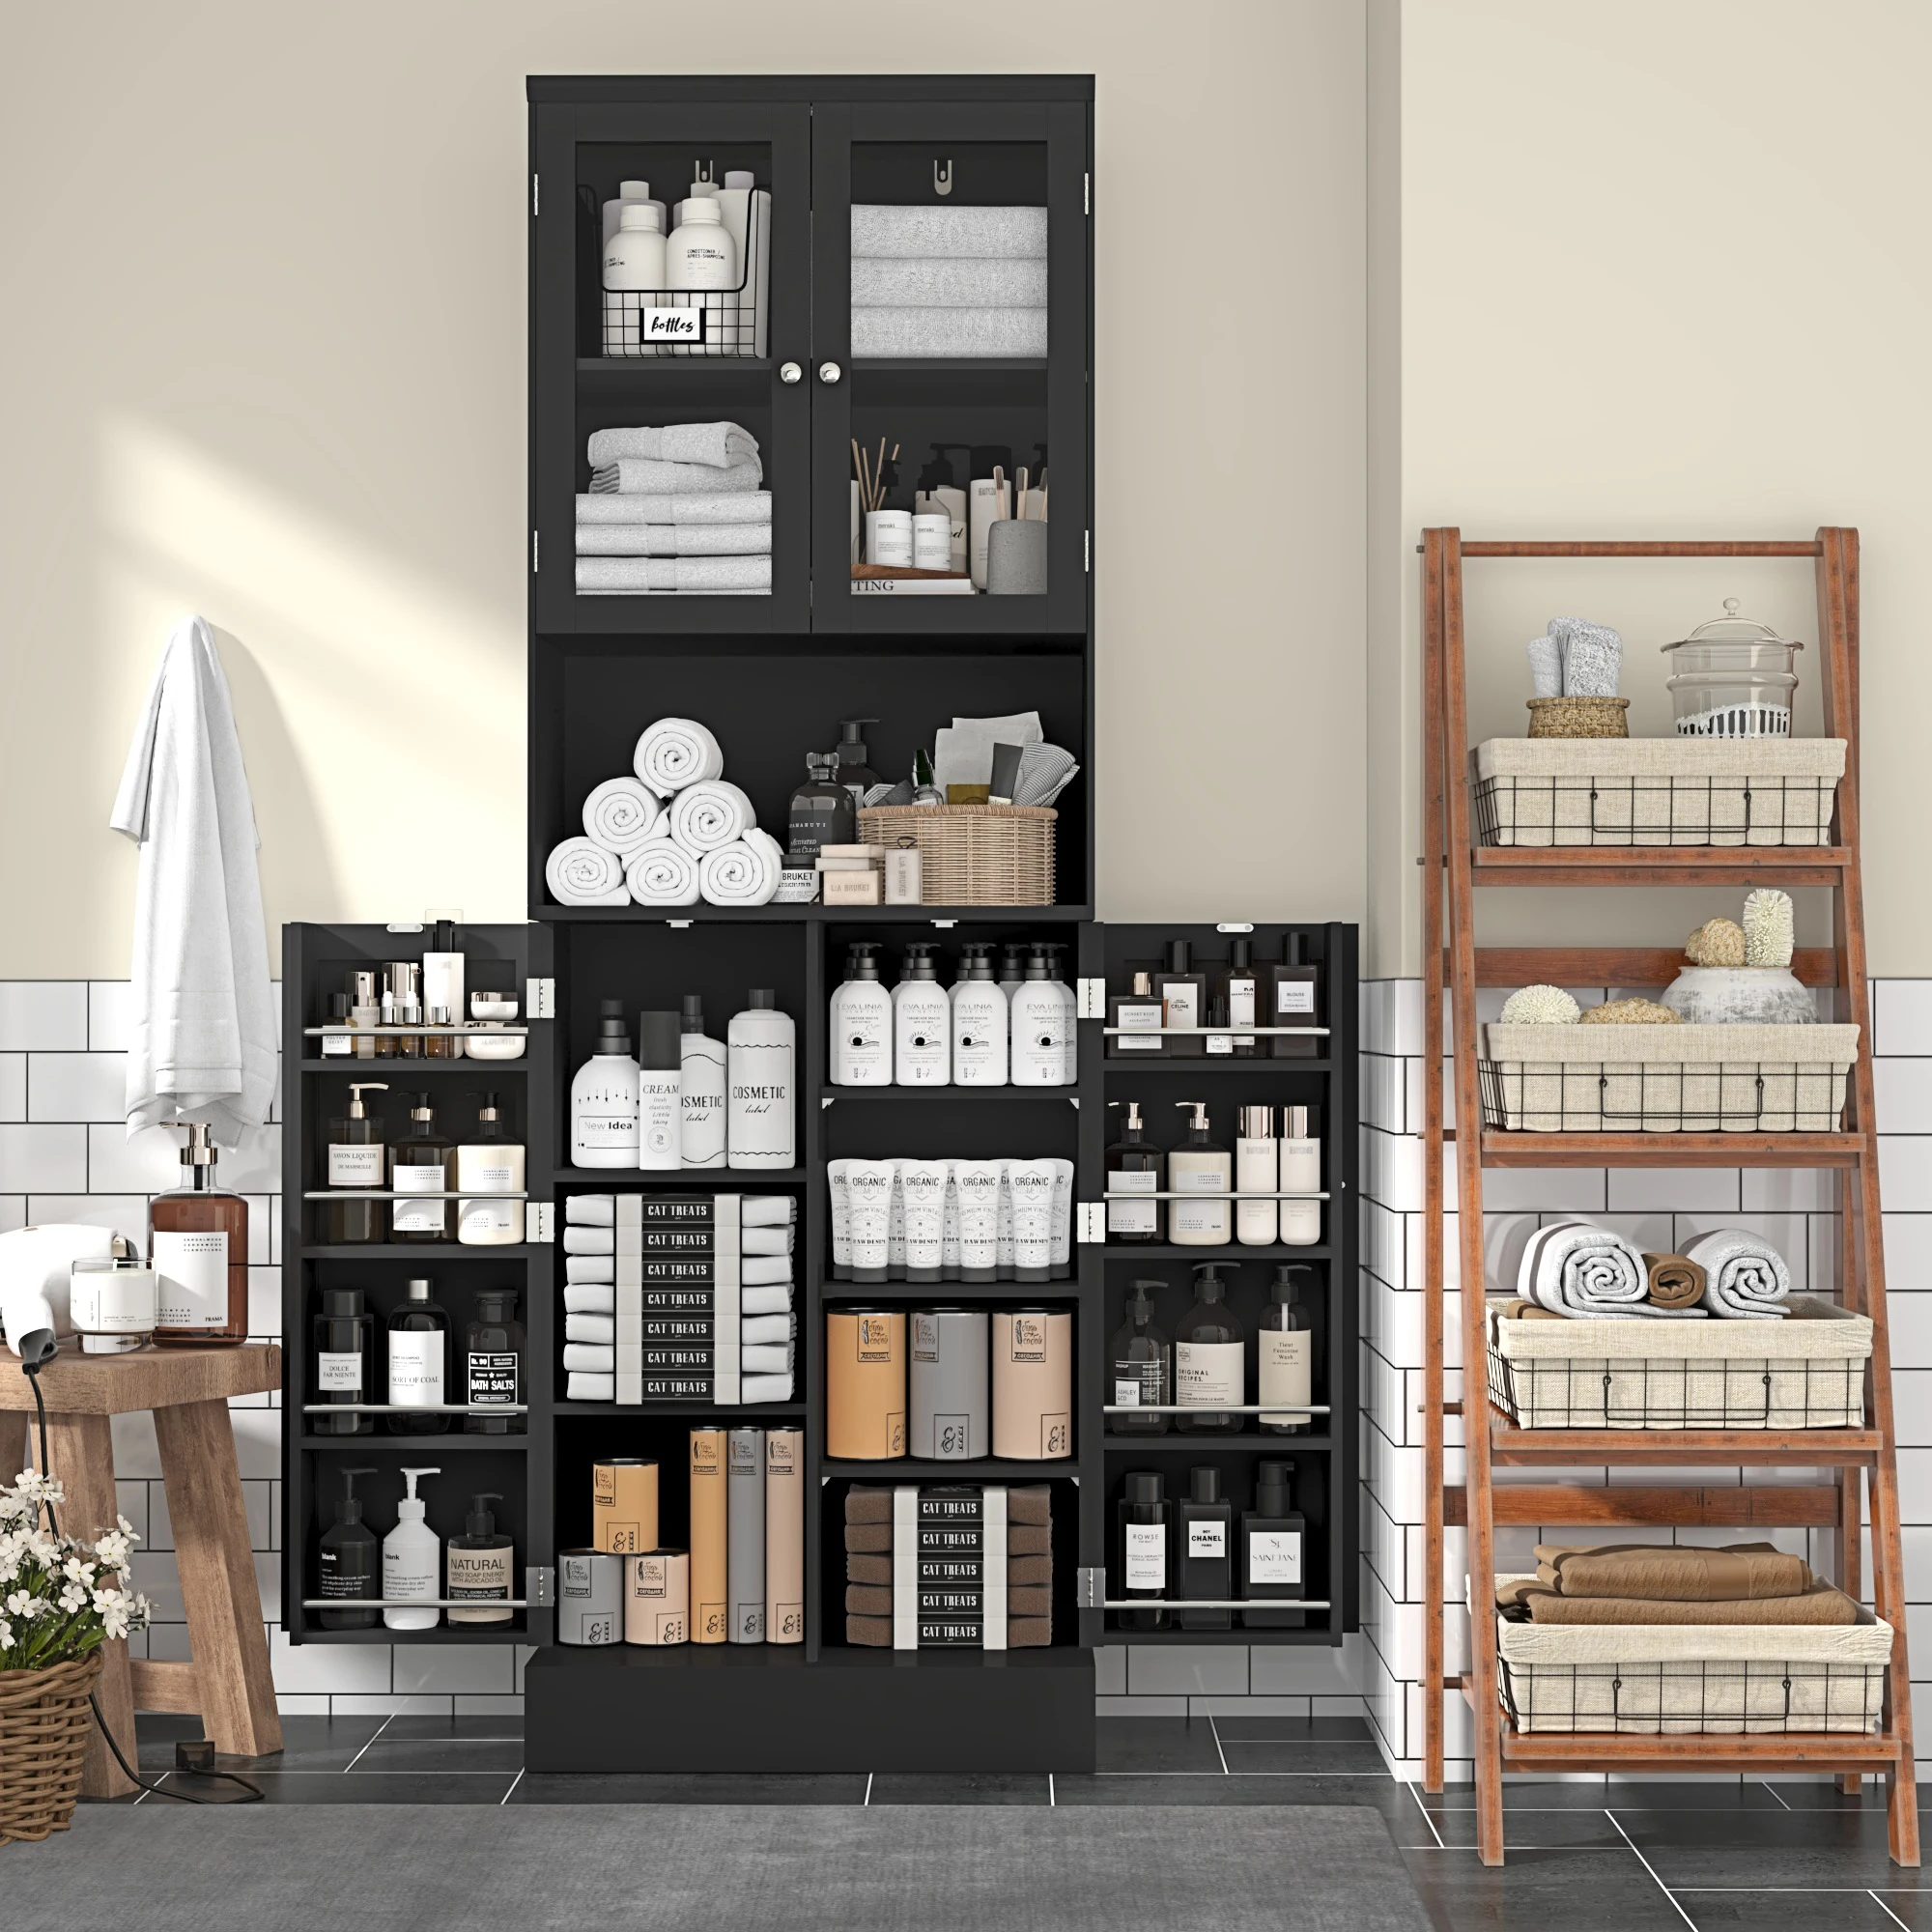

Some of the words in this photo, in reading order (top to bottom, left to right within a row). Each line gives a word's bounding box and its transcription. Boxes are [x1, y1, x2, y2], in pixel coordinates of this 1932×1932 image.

[651, 316, 696, 332] bottles
[781, 872, 813, 881] BRUKET
[642, 1084, 679, 1094] CREAM
[732, 1086, 785, 1099] COSMETIC
[584, 1122, 606, 1130] New
[609, 1122, 633, 1130] Idea
[352, 1152, 379, 1161] LIQUIDE
[852, 1177, 887, 1187] ORGANIC
[906, 1177, 940, 1187] ORGANIC
[962, 1177, 996, 1187] ORGANIC
[1015, 1177, 1049, 1187] ORGANIC
[647, 1206, 667, 1216] CAT
[670, 1206, 707, 1216] TREATS
[647, 1235, 667, 1245] CAT
[670, 1235, 707, 1245] TREATS
[647, 1264, 667, 1276] CAT
[670, 1264, 707, 1276] TREATS
[647, 1294, 667, 1305] CAT
[670, 1294, 707, 1305] TREATS
[647, 1323, 667, 1334] CAT
[670, 1323, 707, 1334] TREATS
[647, 1352, 667, 1364] CAT
[670, 1352, 707, 1364] TREATS
[470, 1378, 489, 1391] BATH
[491, 1379, 515, 1391] SALTS
[647, 1382, 667, 1393] CAT
[670, 1382, 707, 1393] TREATS
[923, 1502, 940, 1514] CAT
[943, 1502, 977, 1514] TREATS
[923, 1533, 940, 1545] CAT
[943, 1533, 977, 1545] TREATS
[321, 1552, 337, 1561] blank
[450, 1558, 505, 1571] NATURAL
[923, 1564, 940, 1576] CAT
[943, 1564, 977, 1576] TREATS
[923, 1595, 940, 1606] CAT
[943, 1595, 977, 1606] TREATS
[923, 1626, 940, 1637] CAT
[943, 1626, 977, 1637] TREATS
